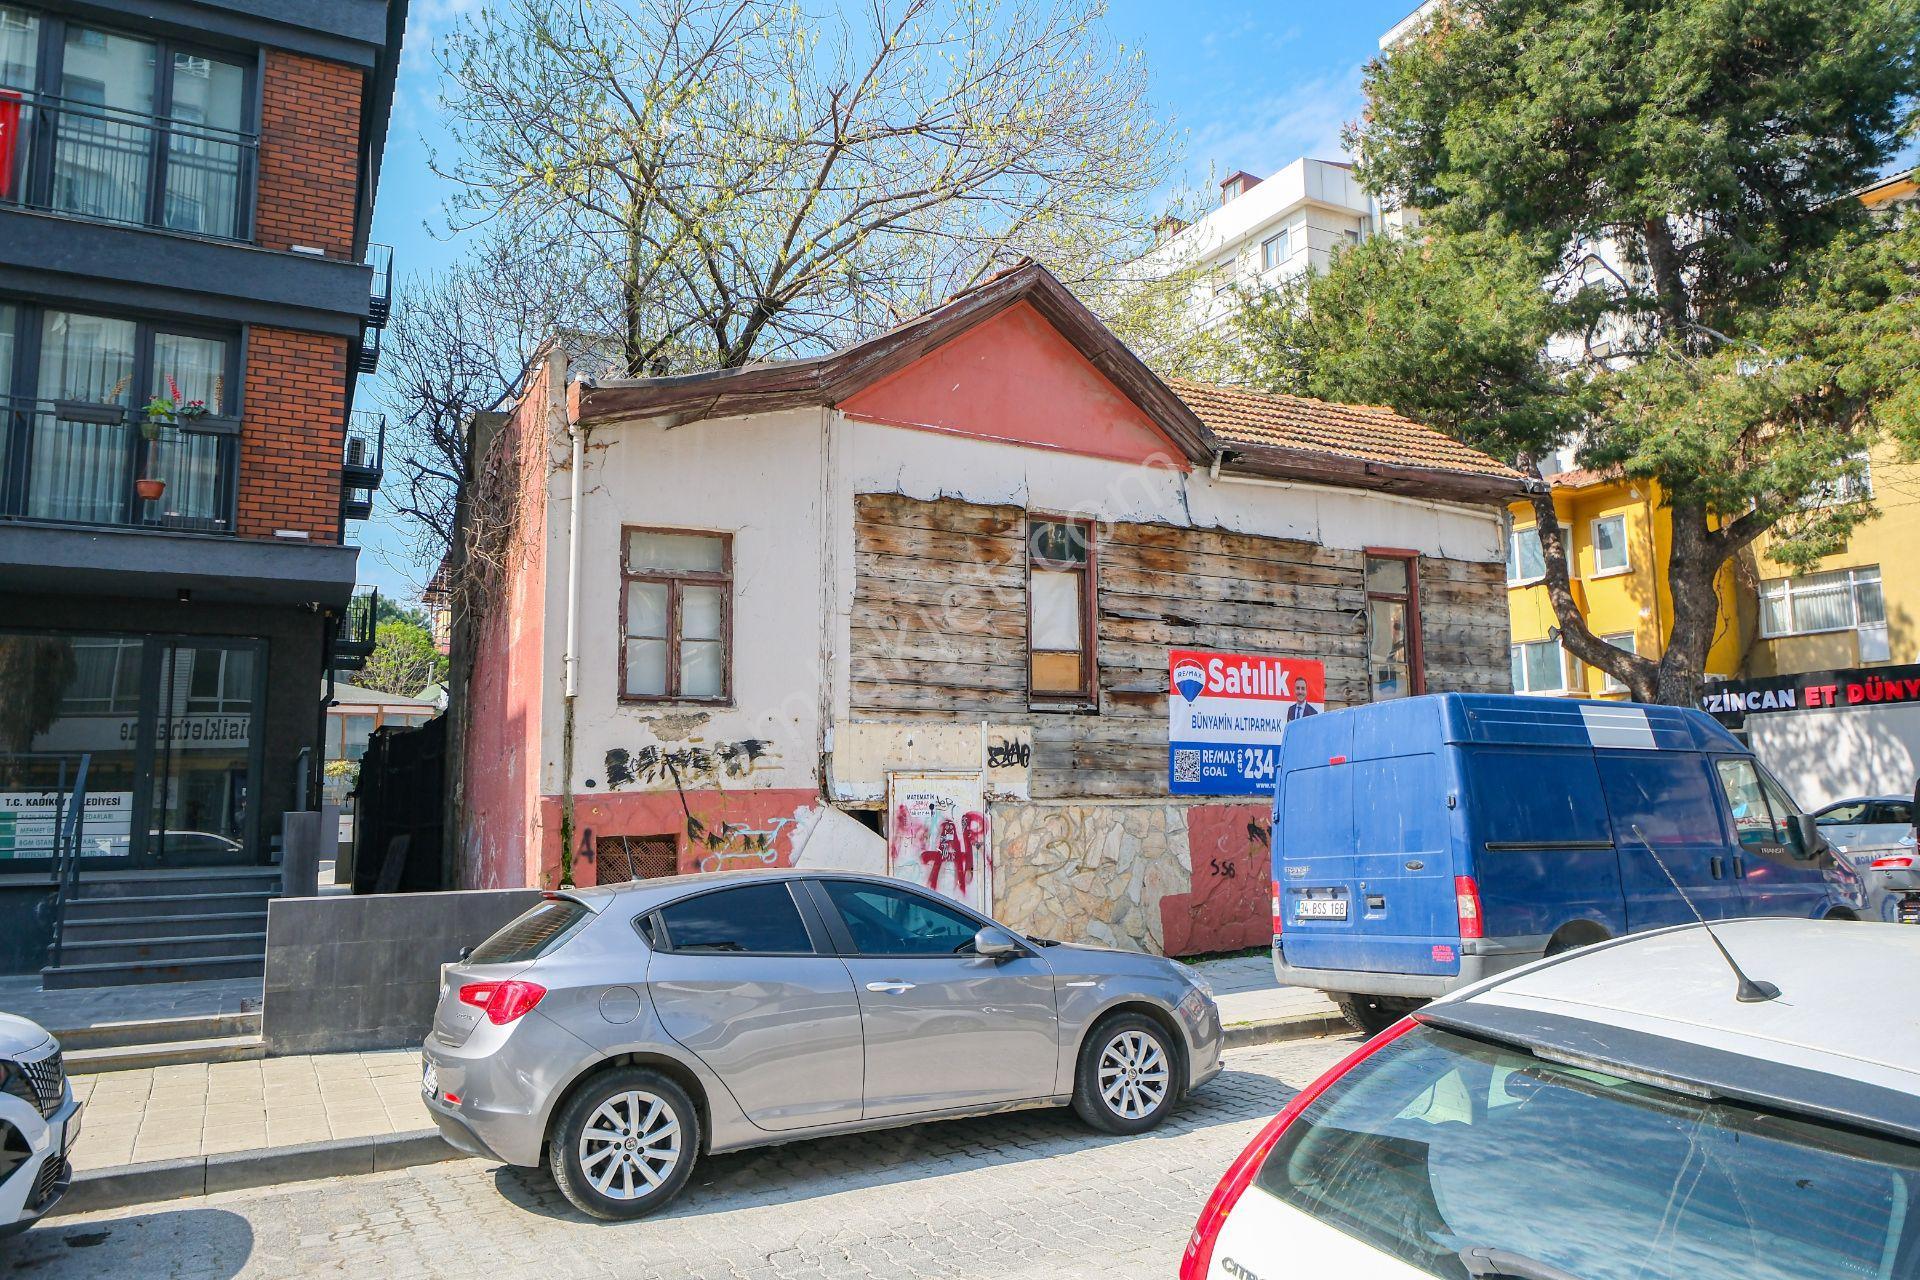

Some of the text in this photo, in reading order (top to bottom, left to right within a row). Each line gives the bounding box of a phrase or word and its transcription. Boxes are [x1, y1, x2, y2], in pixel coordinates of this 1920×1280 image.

[1177, 671, 1202, 679] RE/MAX
[1208, 658, 1291, 697] Satılık
[1804, 685, 1837, 706] ET
[1191, 713, 1281, 732] BÜNYAMİN ALTIPARMAK
[1202, 749, 1236, 764] RE/MAX
[1244, 748, 1275, 780] 234
[1202, 766, 1228, 777] GOAL
[1312, 902, 1327, 915] BSS
